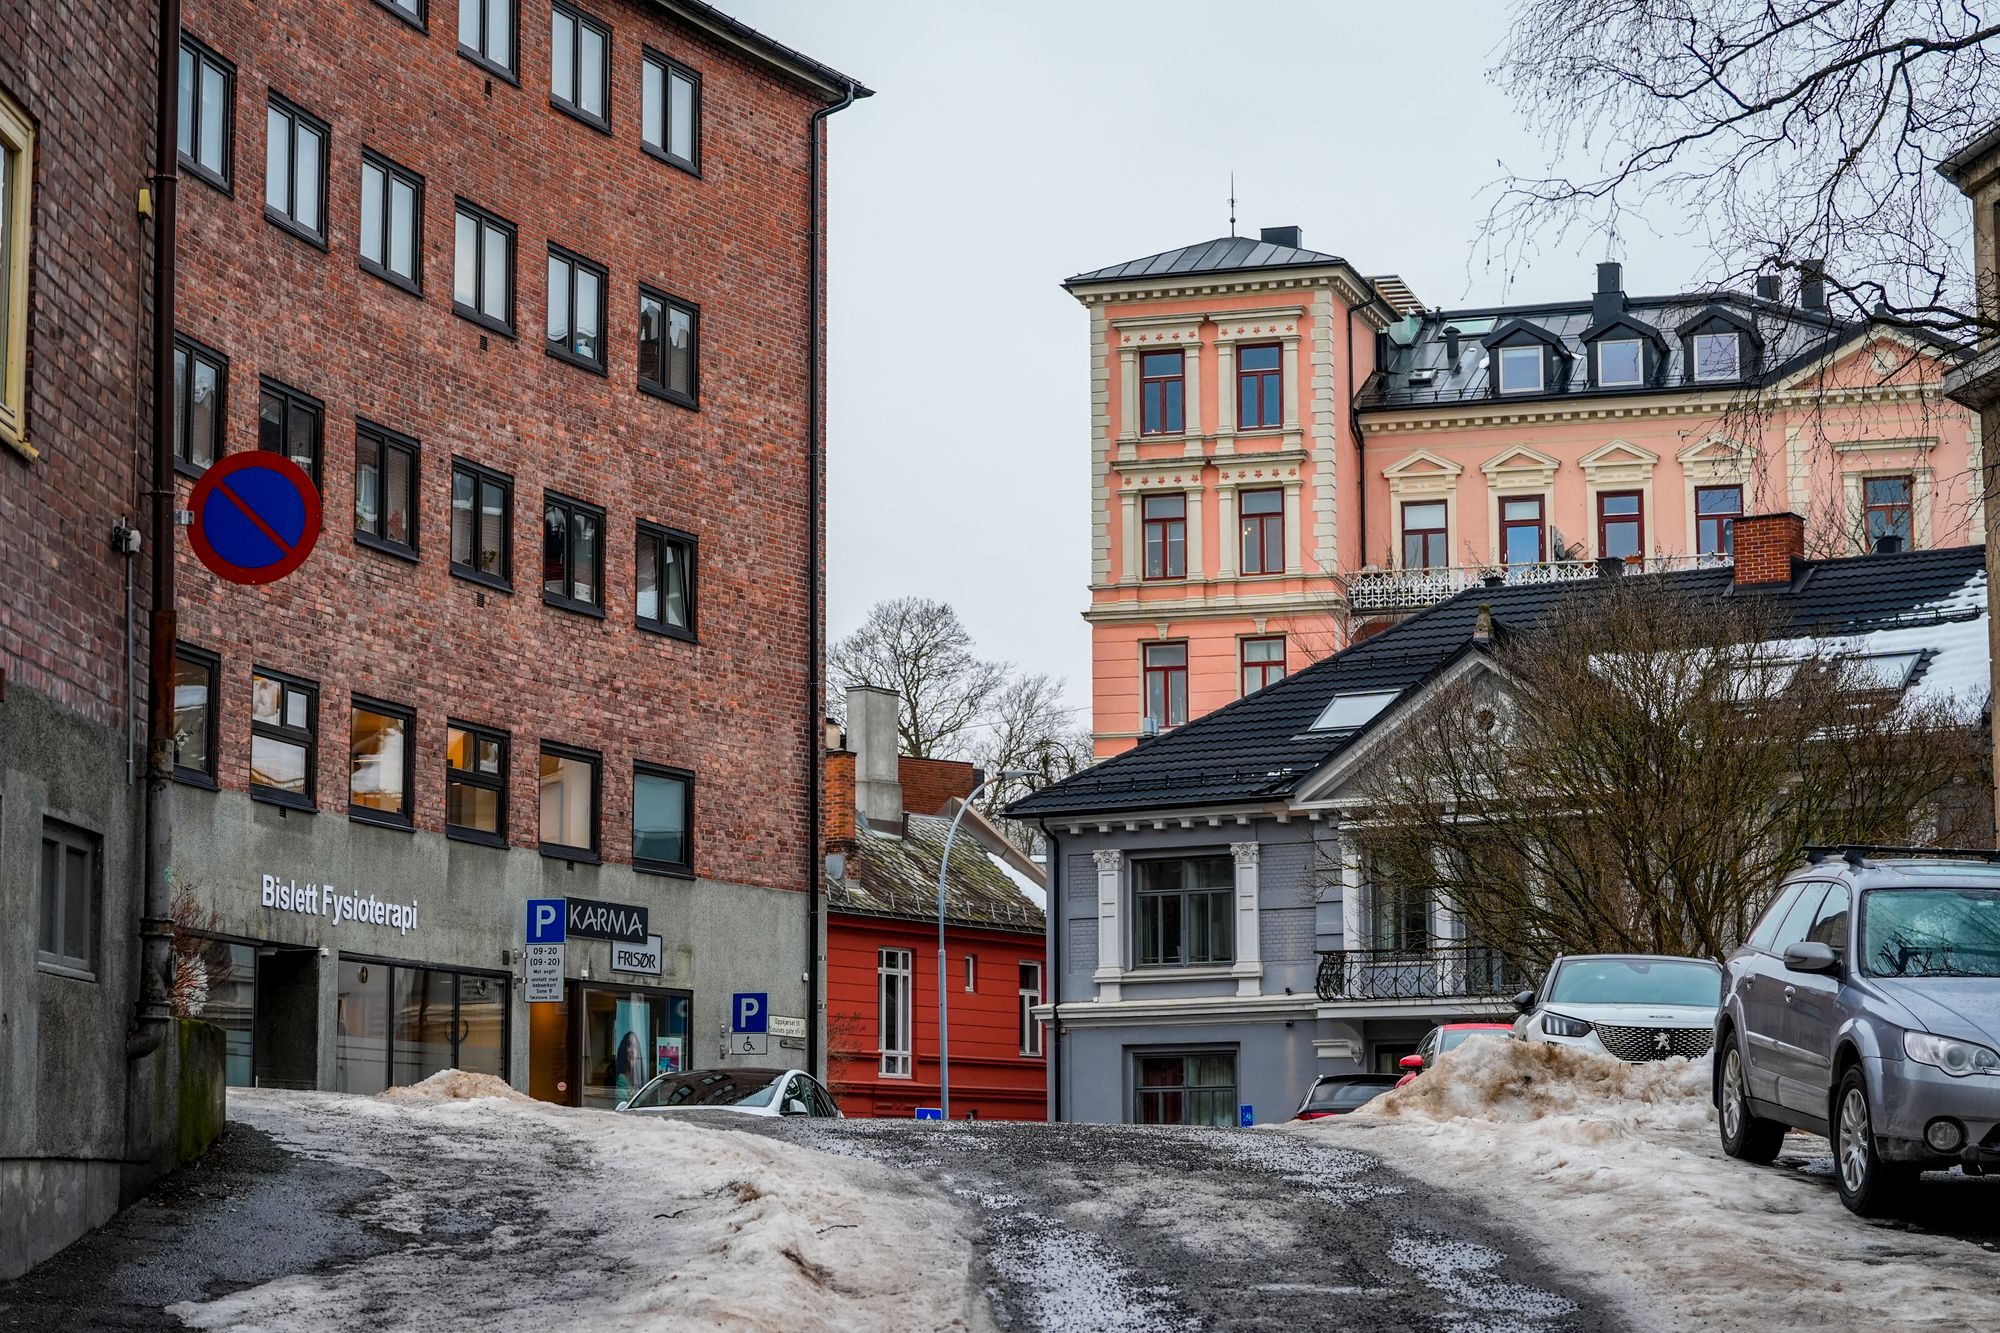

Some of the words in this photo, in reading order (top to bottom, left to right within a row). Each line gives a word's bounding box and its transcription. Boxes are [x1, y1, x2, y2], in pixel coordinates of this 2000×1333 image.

[262, 874, 318, 915] Bislett
[322, 884, 418, 936] Fysioterapi
[536, 905, 556, 938] P
[569, 904, 643, 937] KARMA
[617, 950, 656, 969] FRISØR
[740, 998, 759, 1028] P
